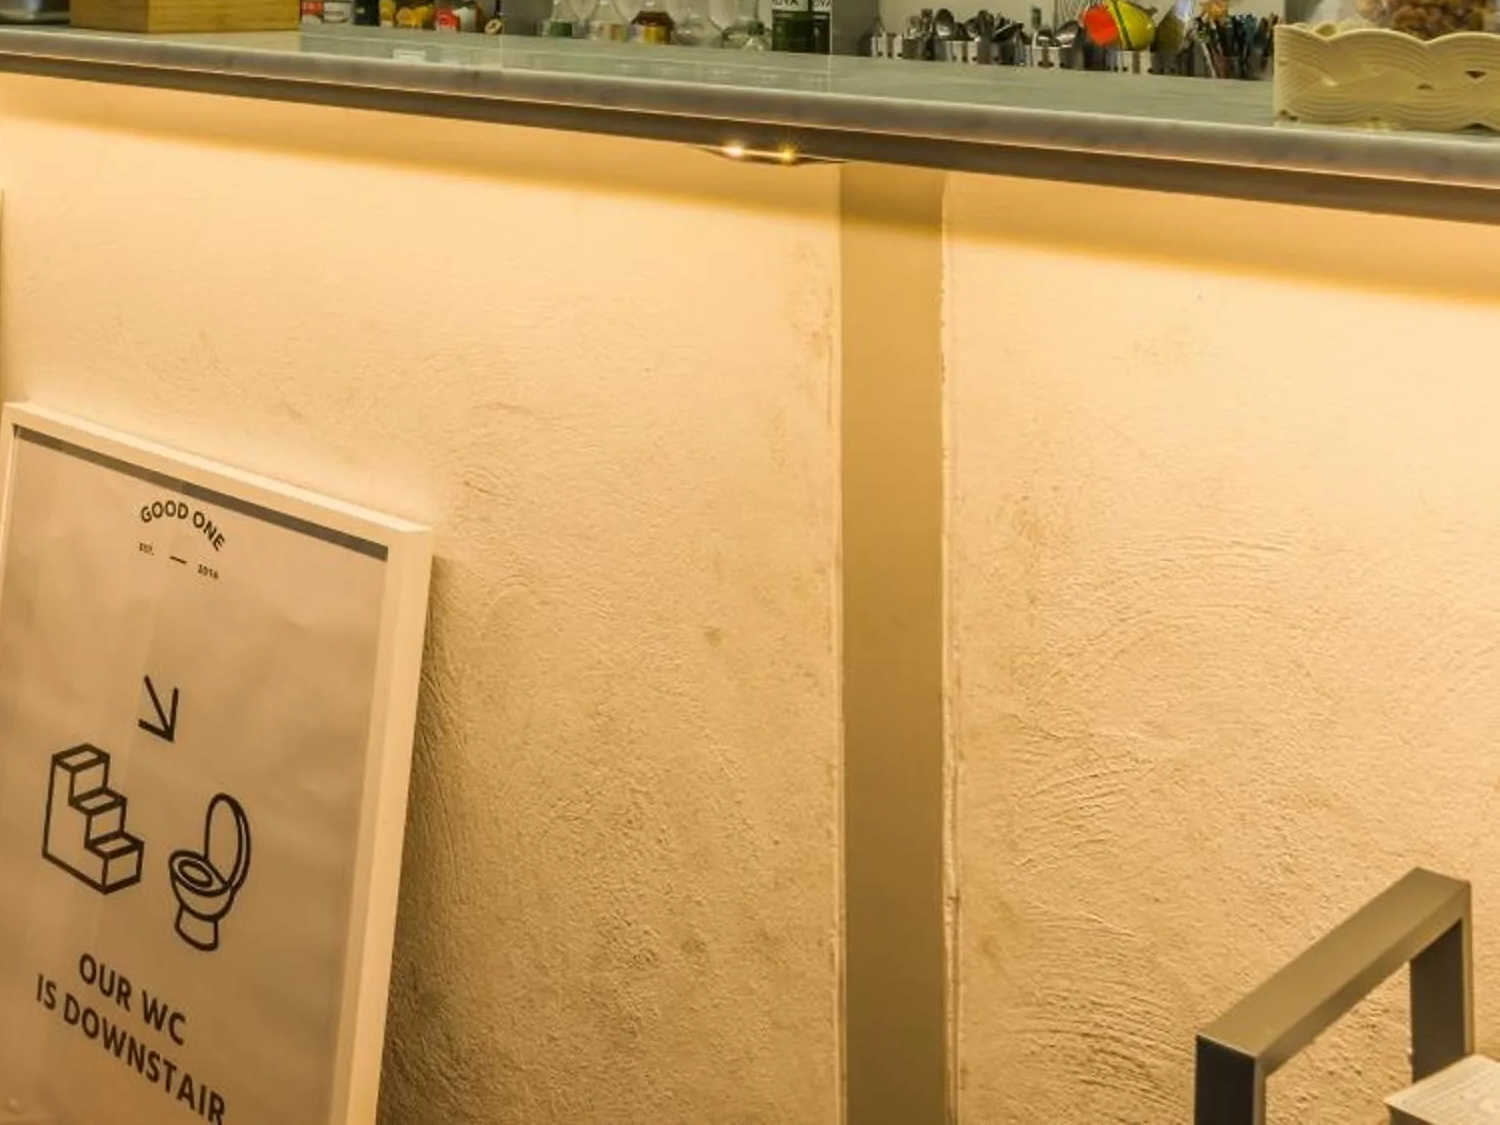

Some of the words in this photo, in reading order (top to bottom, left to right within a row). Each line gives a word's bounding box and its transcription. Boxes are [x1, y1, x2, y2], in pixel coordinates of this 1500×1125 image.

[140, 500, 190, 524] GOOD
[192, 511, 226, 552] ONE
[78, 952, 133, 1013] OUR
[141, 988, 187, 1047] WC
[36, 972, 57, 1011] IS
[63, 991, 226, 1125] DOWNSTAIR
